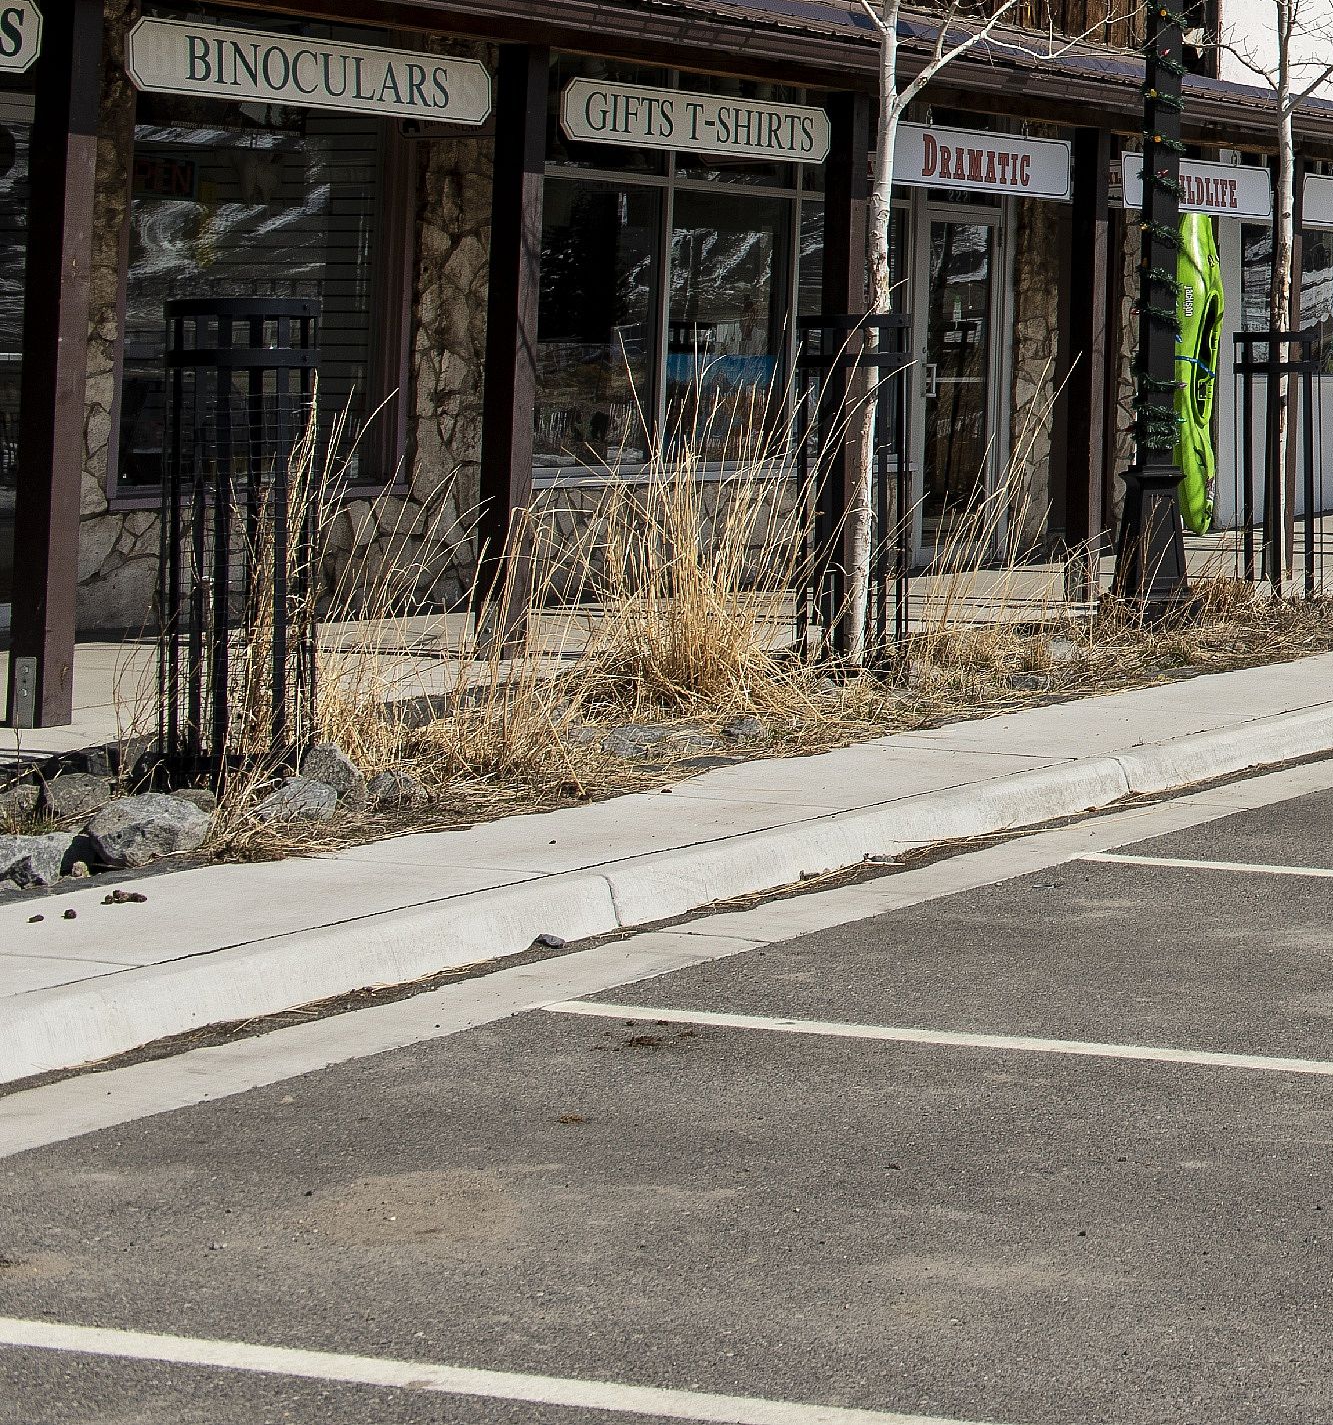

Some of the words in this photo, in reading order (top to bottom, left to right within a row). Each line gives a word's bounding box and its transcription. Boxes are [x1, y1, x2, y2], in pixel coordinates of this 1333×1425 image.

[184, 34, 449, 109] BINOCULARS
[585, 90, 674, 138] GIFTS
[686, 102, 814, 152] T-SHIRTS
[922, 133, 1031, 187] DRAMATIC
[1179, 174, 1238, 208] ILDLIFE
